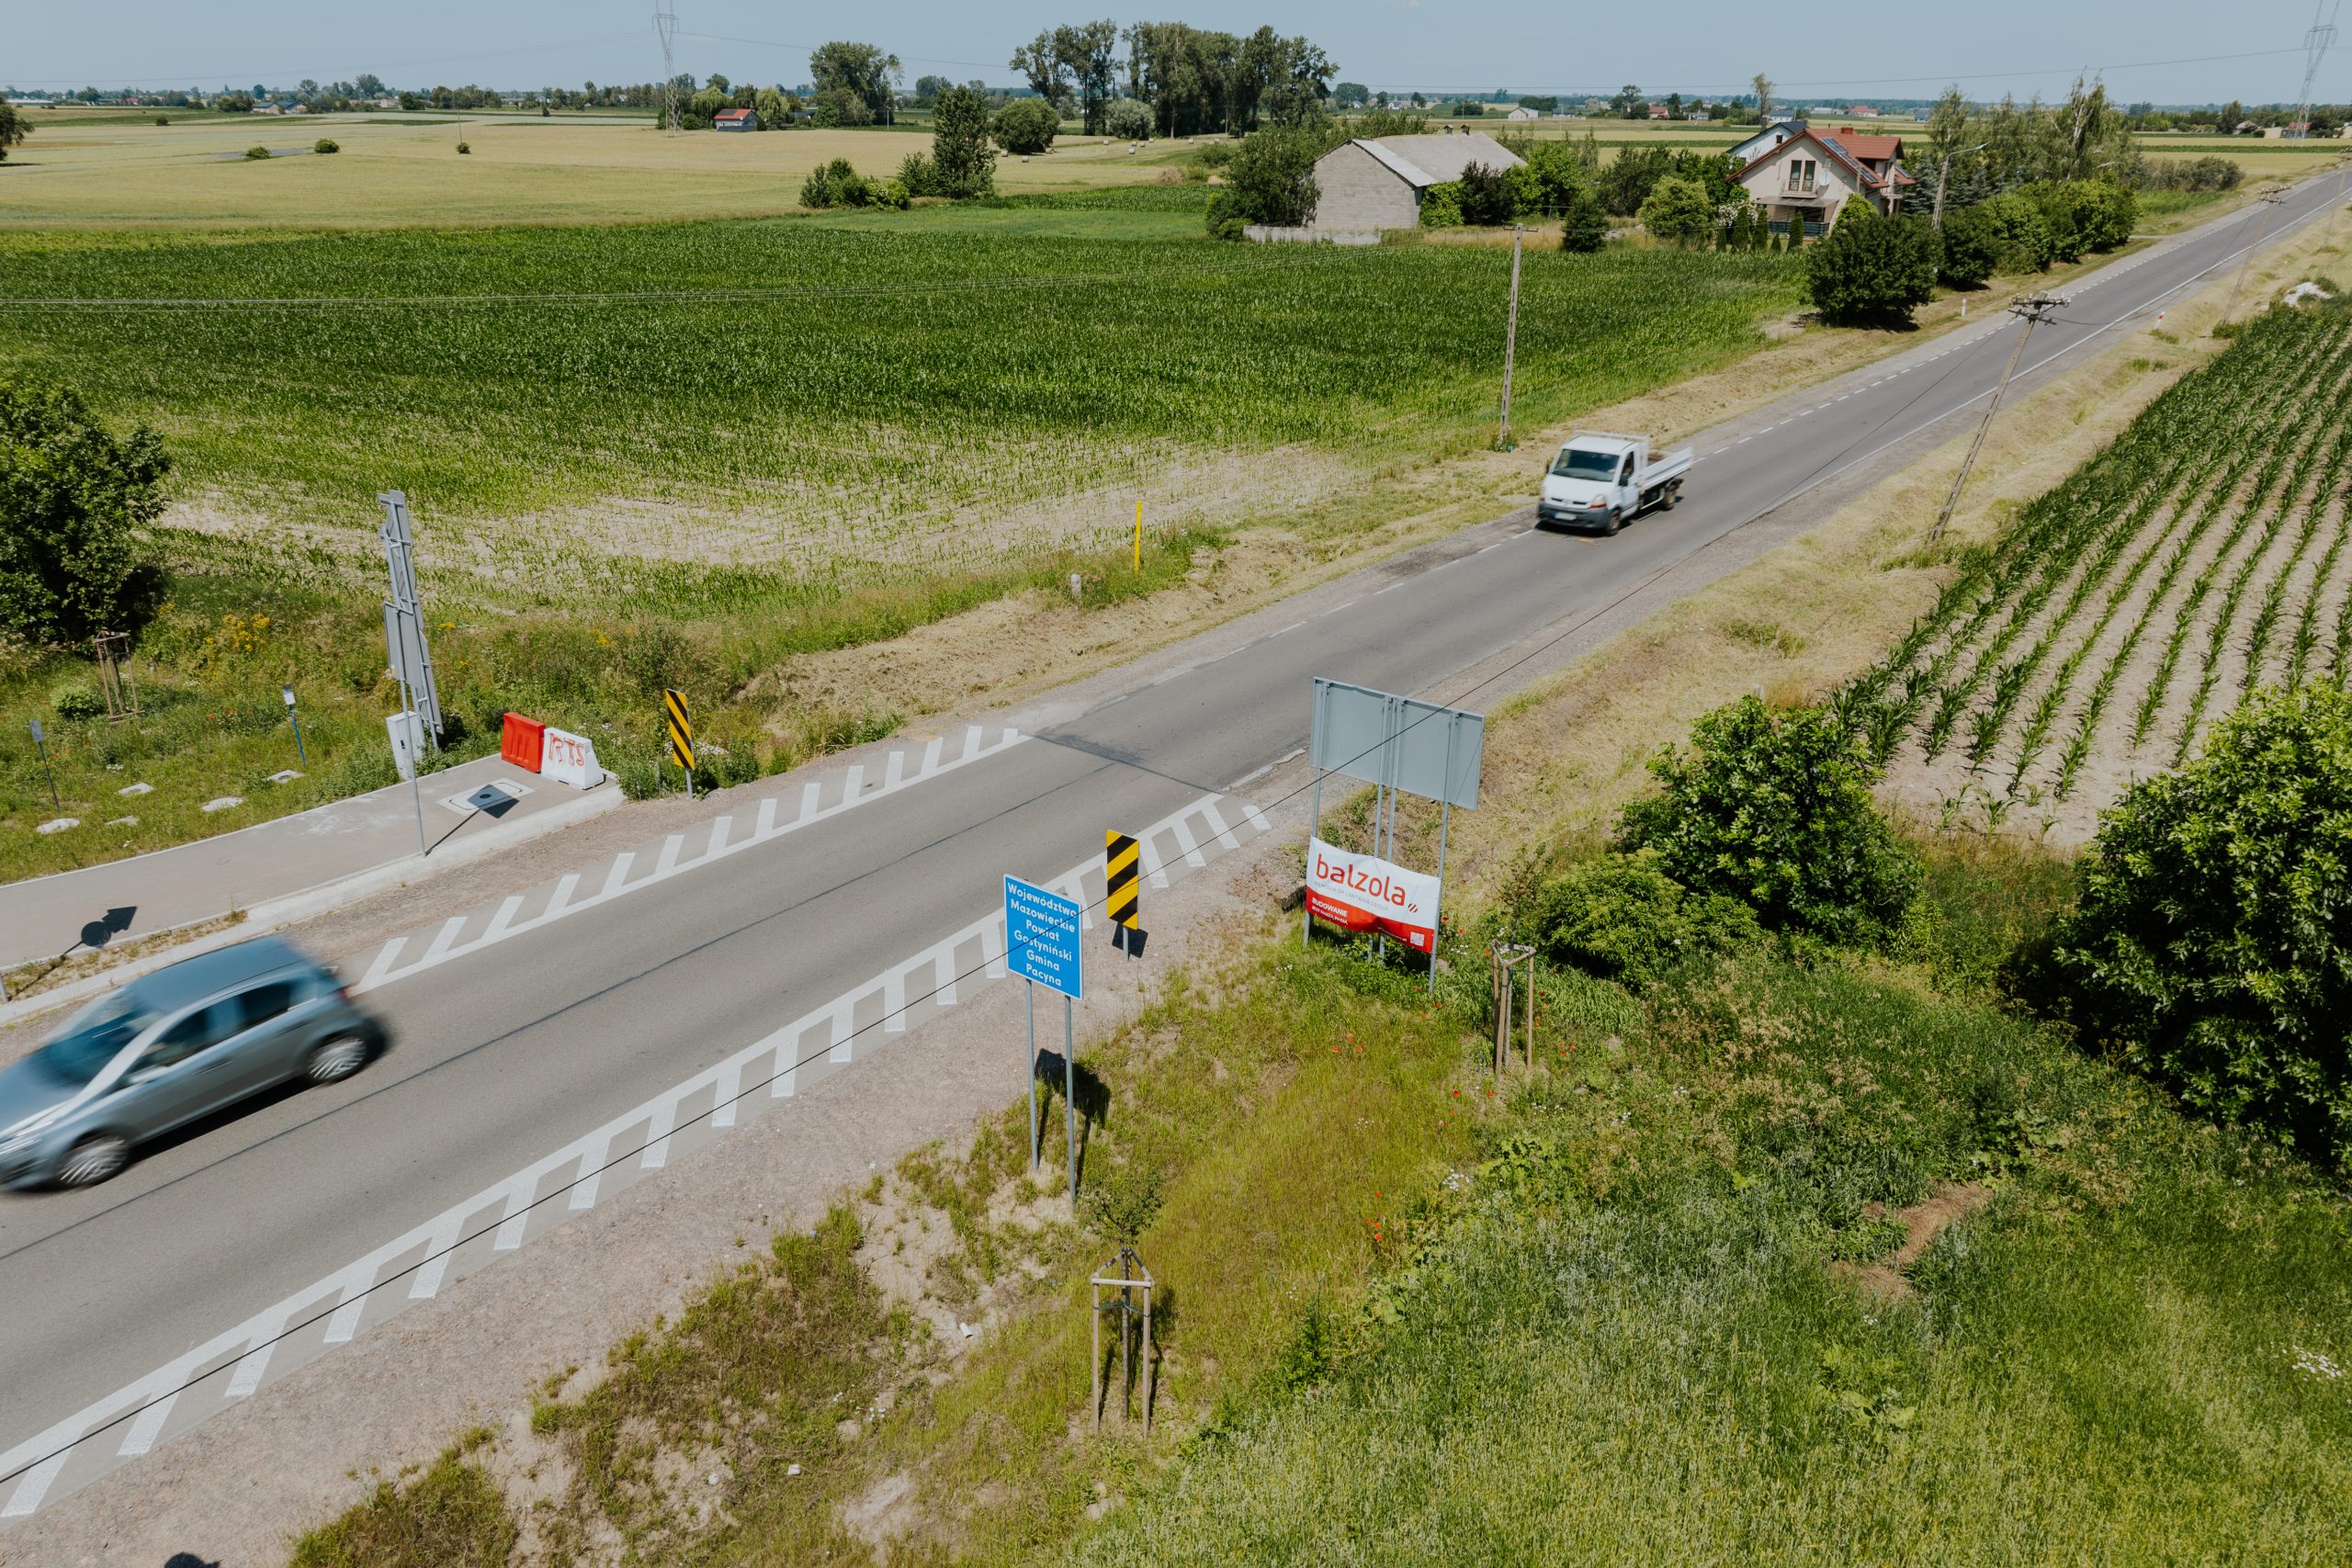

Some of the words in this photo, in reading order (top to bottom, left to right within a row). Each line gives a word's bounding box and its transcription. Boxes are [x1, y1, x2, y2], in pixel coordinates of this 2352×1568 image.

[1316, 852, 1406, 906] balzola
[1007, 883, 1077, 918] Województwo
[1312, 897, 1348, 918] BUDOWANIE
[1011, 898, 1076, 933] Mazowieckie
[1026, 919, 1059, 942] Powiat
[1014, 930, 1072, 962] Gostyniński
[1026, 949, 1060, 972] Gmina
[1026, 963, 1062, 987] Pacyna
